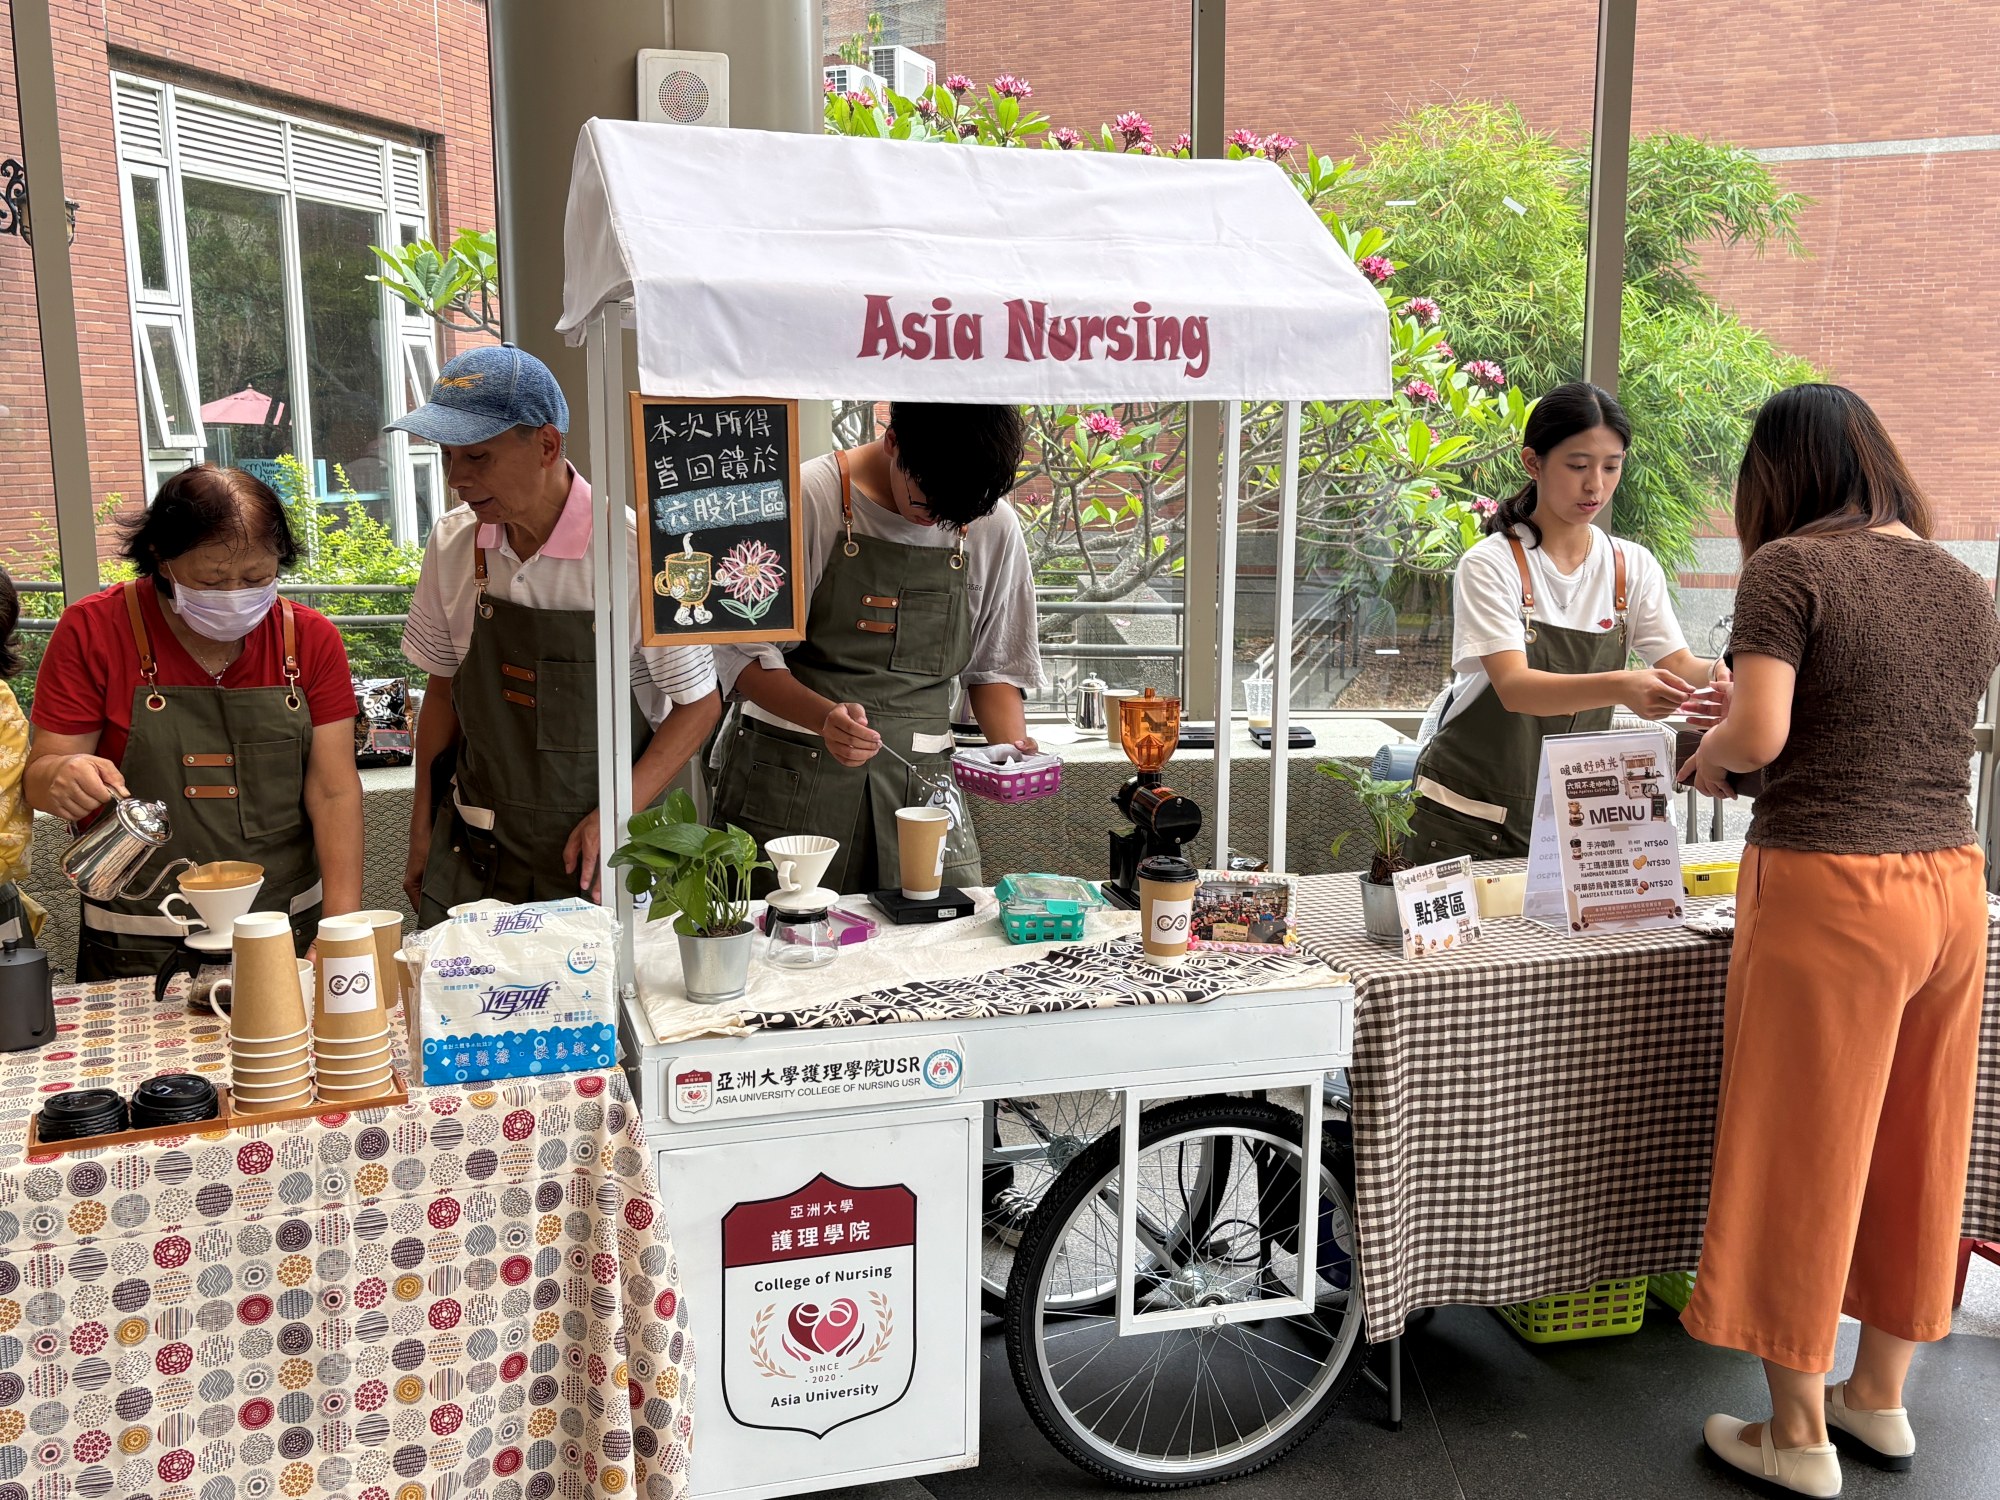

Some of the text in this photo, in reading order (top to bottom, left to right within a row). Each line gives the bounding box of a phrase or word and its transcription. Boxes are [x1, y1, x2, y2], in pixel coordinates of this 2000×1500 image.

[856, 294, 1211, 379] Asia Nursing
[650, 408, 771, 446] 本次所得
[654, 444, 779, 490] 皆回饋於
[666, 487, 785, 527] 六股社區
[1560, 756, 1619, 776] 暖暖好時光
[1589, 806, 1645, 825] MENU
[1587, 840, 1615, 850] 手沖咖啡
[1644, 840, 1669, 848] NT$60
[1579, 859, 1671, 872] 手工瑪德蓮蛋糕 NT$30
[1649, 880, 1674, 888] NT$20
[1414, 891, 1466, 927] 點餐區
[716, 1096, 738, 1105] ASIA
[739, 1090, 795, 1103] UNIVERSITY
[797, 1085, 841, 1097] COLLEGE
[843, 1083, 855, 1093] OF
[858, 1079, 900, 1092] NURSING
[901, 1077, 921, 1087] USR
[790, 1199, 854, 1220] 亞洲大學
[771, 1220, 870, 1252] 護理學院
[754, 1265, 893, 1292] College of Nursing
[809, 1362, 840, 1374] SINCE
[812, 1373, 837, 1384] 2020
[771, 1383, 879, 1408] Asia University
